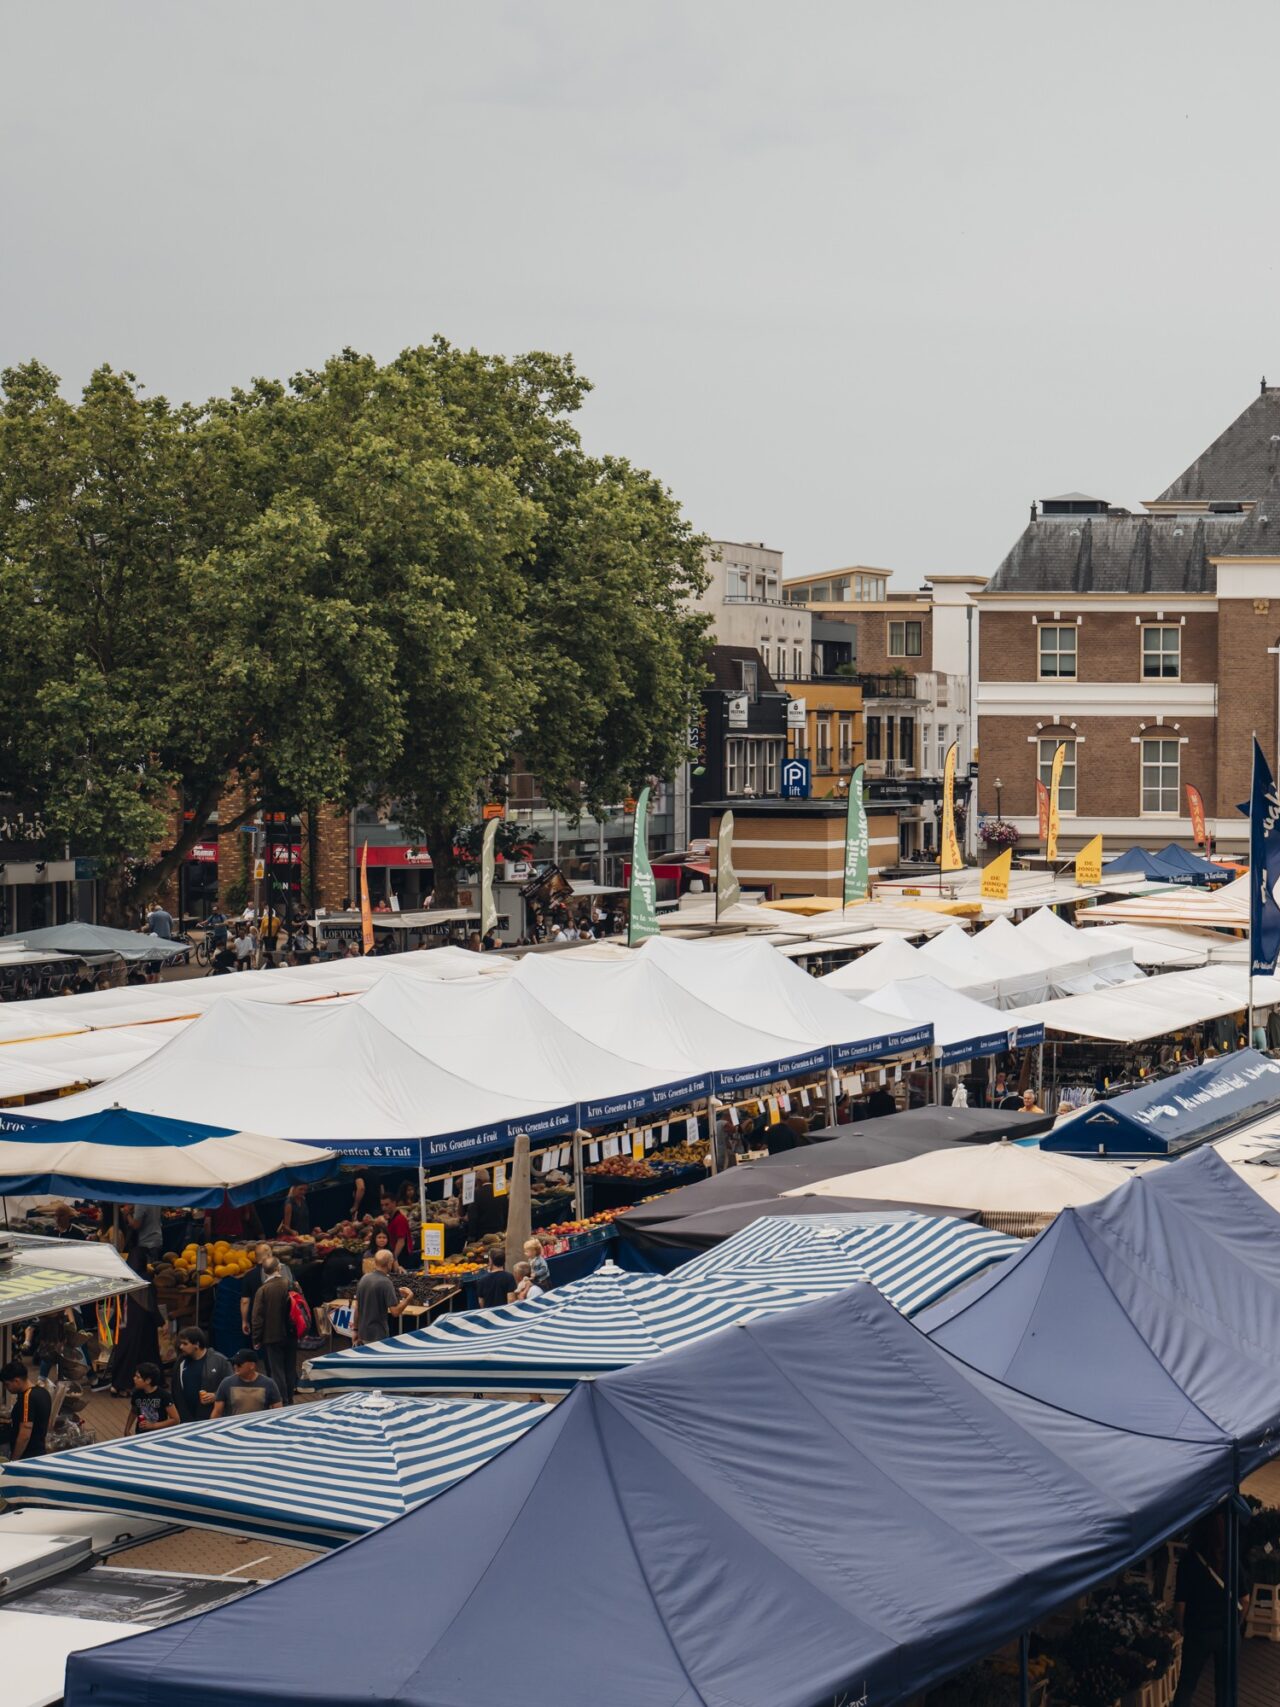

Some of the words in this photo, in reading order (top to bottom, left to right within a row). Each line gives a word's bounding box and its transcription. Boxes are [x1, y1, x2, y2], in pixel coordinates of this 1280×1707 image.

[789, 768, 801, 785] P
[789, 786, 801, 796] lift
[846, 838, 860, 877] Smit
[324, 929, 363, 939] LOEMPIA'
[778, 1061, 790, 1073] kros
[720, 1073, 734, 1084] kros
[760, 1068, 771, 1078] Fruit
[653, 1090, 667, 1102] kros
[668, 1087, 688, 1099] Groenten
[693, 1081, 705, 1092] Fruit
[587, 1105, 602, 1118] kros
[604, 1103, 627, 1114] Groenten
[632, 1097, 645, 1108] Fruit
[0, 1117, 26, 1132] kros
[507, 1123, 523, 1137] kros
[525, 1120, 550, 1133] Groenten
[556, 1114, 569, 1125] Fruit
[430, 1141, 447, 1154] kros
[450, 1138, 476, 1151] Groenten
[483, 1131, 498, 1142] Fruit
[373, 1147, 382, 1156] &
[386, 1147, 411, 1157] Fruit
